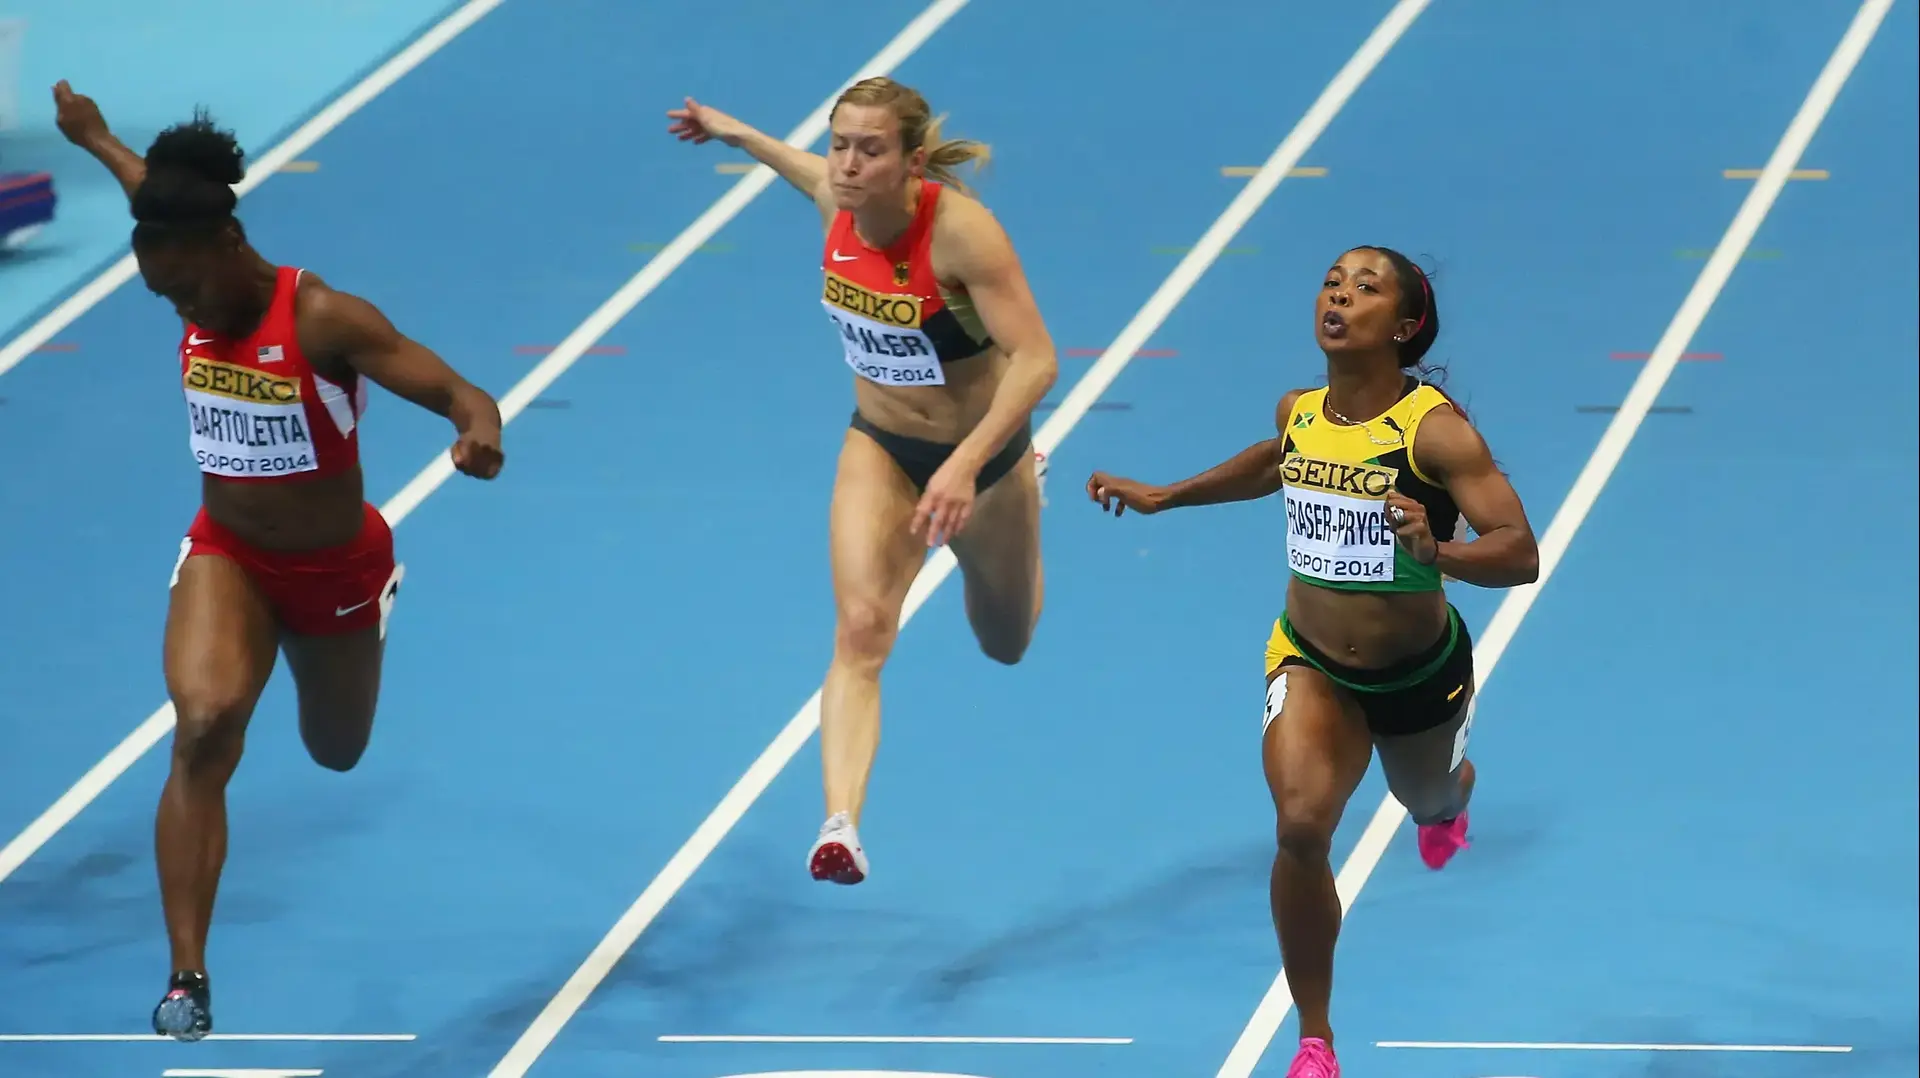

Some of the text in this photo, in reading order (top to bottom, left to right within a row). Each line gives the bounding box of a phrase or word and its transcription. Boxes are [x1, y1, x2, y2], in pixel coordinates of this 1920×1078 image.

[825, 276, 916, 325] SEIKO
[187, 362, 297, 401] SEIKO
[891, 367, 936, 381] 2014
[189, 402, 307, 447] BARTOLETTA
[196, 449, 310, 472] SOPOT 2014
[1283, 456, 1393, 497] SEIKO
[1286, 496, 1391, 546] FRASER-PRYCE
[1290, 548, 1385, 576] SOPOT 2014
